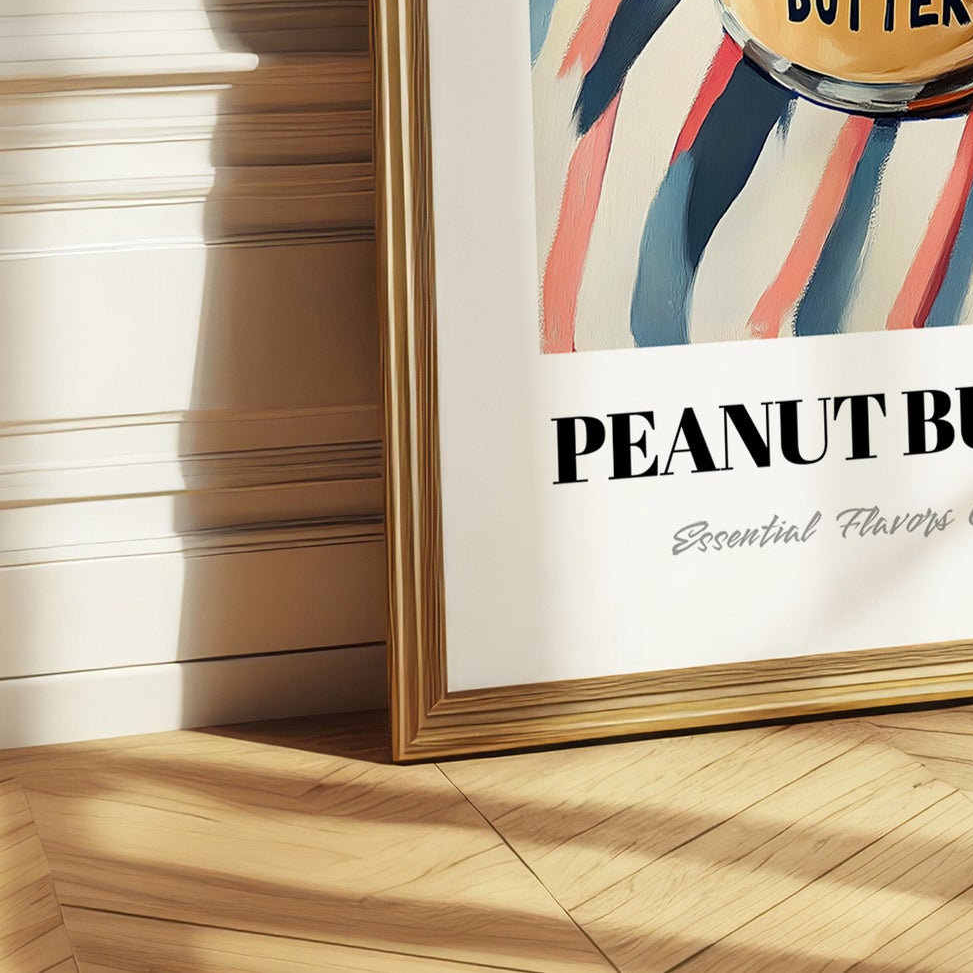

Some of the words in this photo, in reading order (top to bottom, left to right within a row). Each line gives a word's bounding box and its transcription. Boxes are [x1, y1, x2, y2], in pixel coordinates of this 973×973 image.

[551, 393, 887, 485] PEANUT
[671, 511, 823, 556] Essential
[835, 506, 955, 539] Flavors
